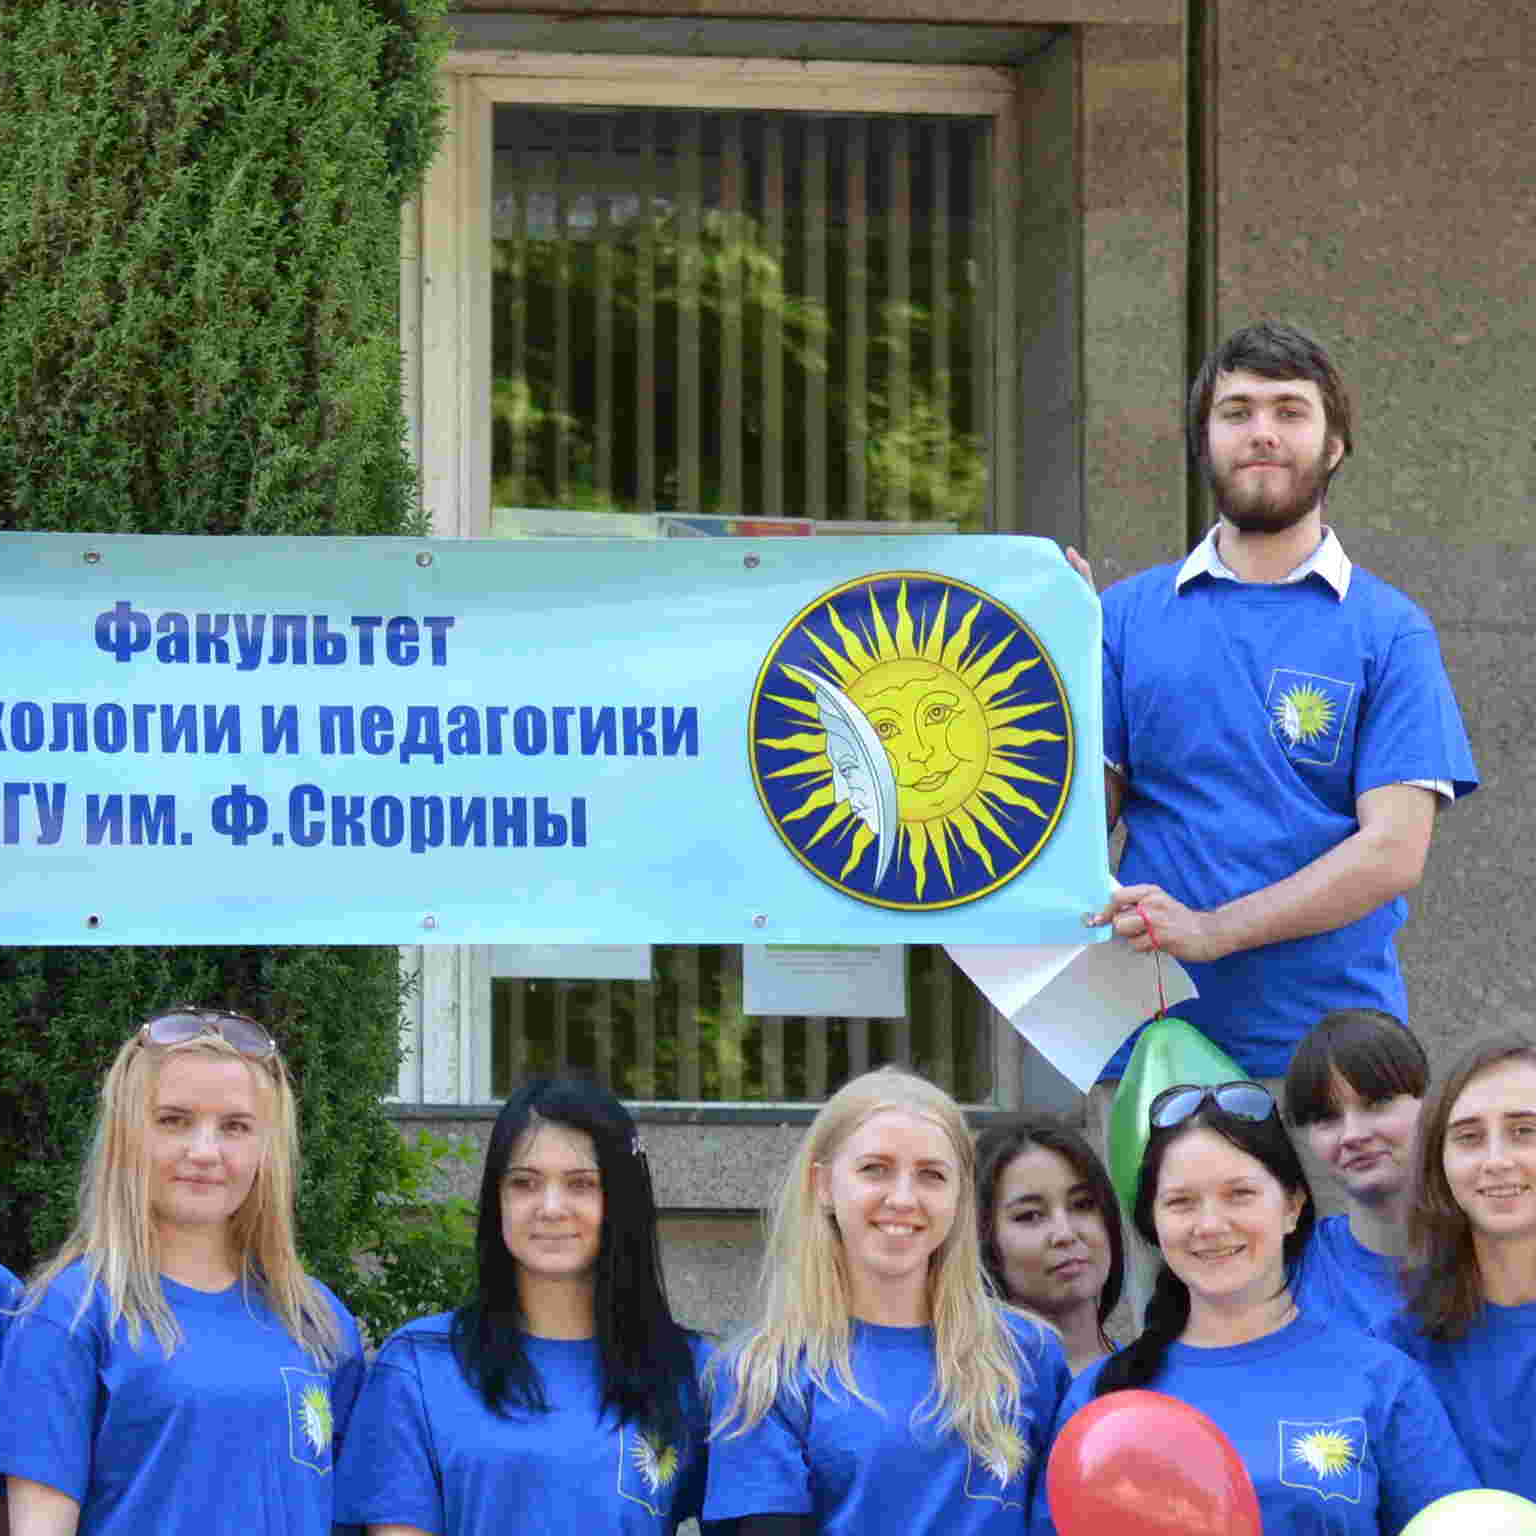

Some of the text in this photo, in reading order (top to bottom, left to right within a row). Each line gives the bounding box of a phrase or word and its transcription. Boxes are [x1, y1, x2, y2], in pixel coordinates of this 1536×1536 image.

[94, 601, 455, 671] Факультет
[261, 705, 299, 754] и
[319, 704, 699, 766] педагогики
[86, 794, 193, 846] им.
[211, 782, 587, 854] Ф.Скорины
